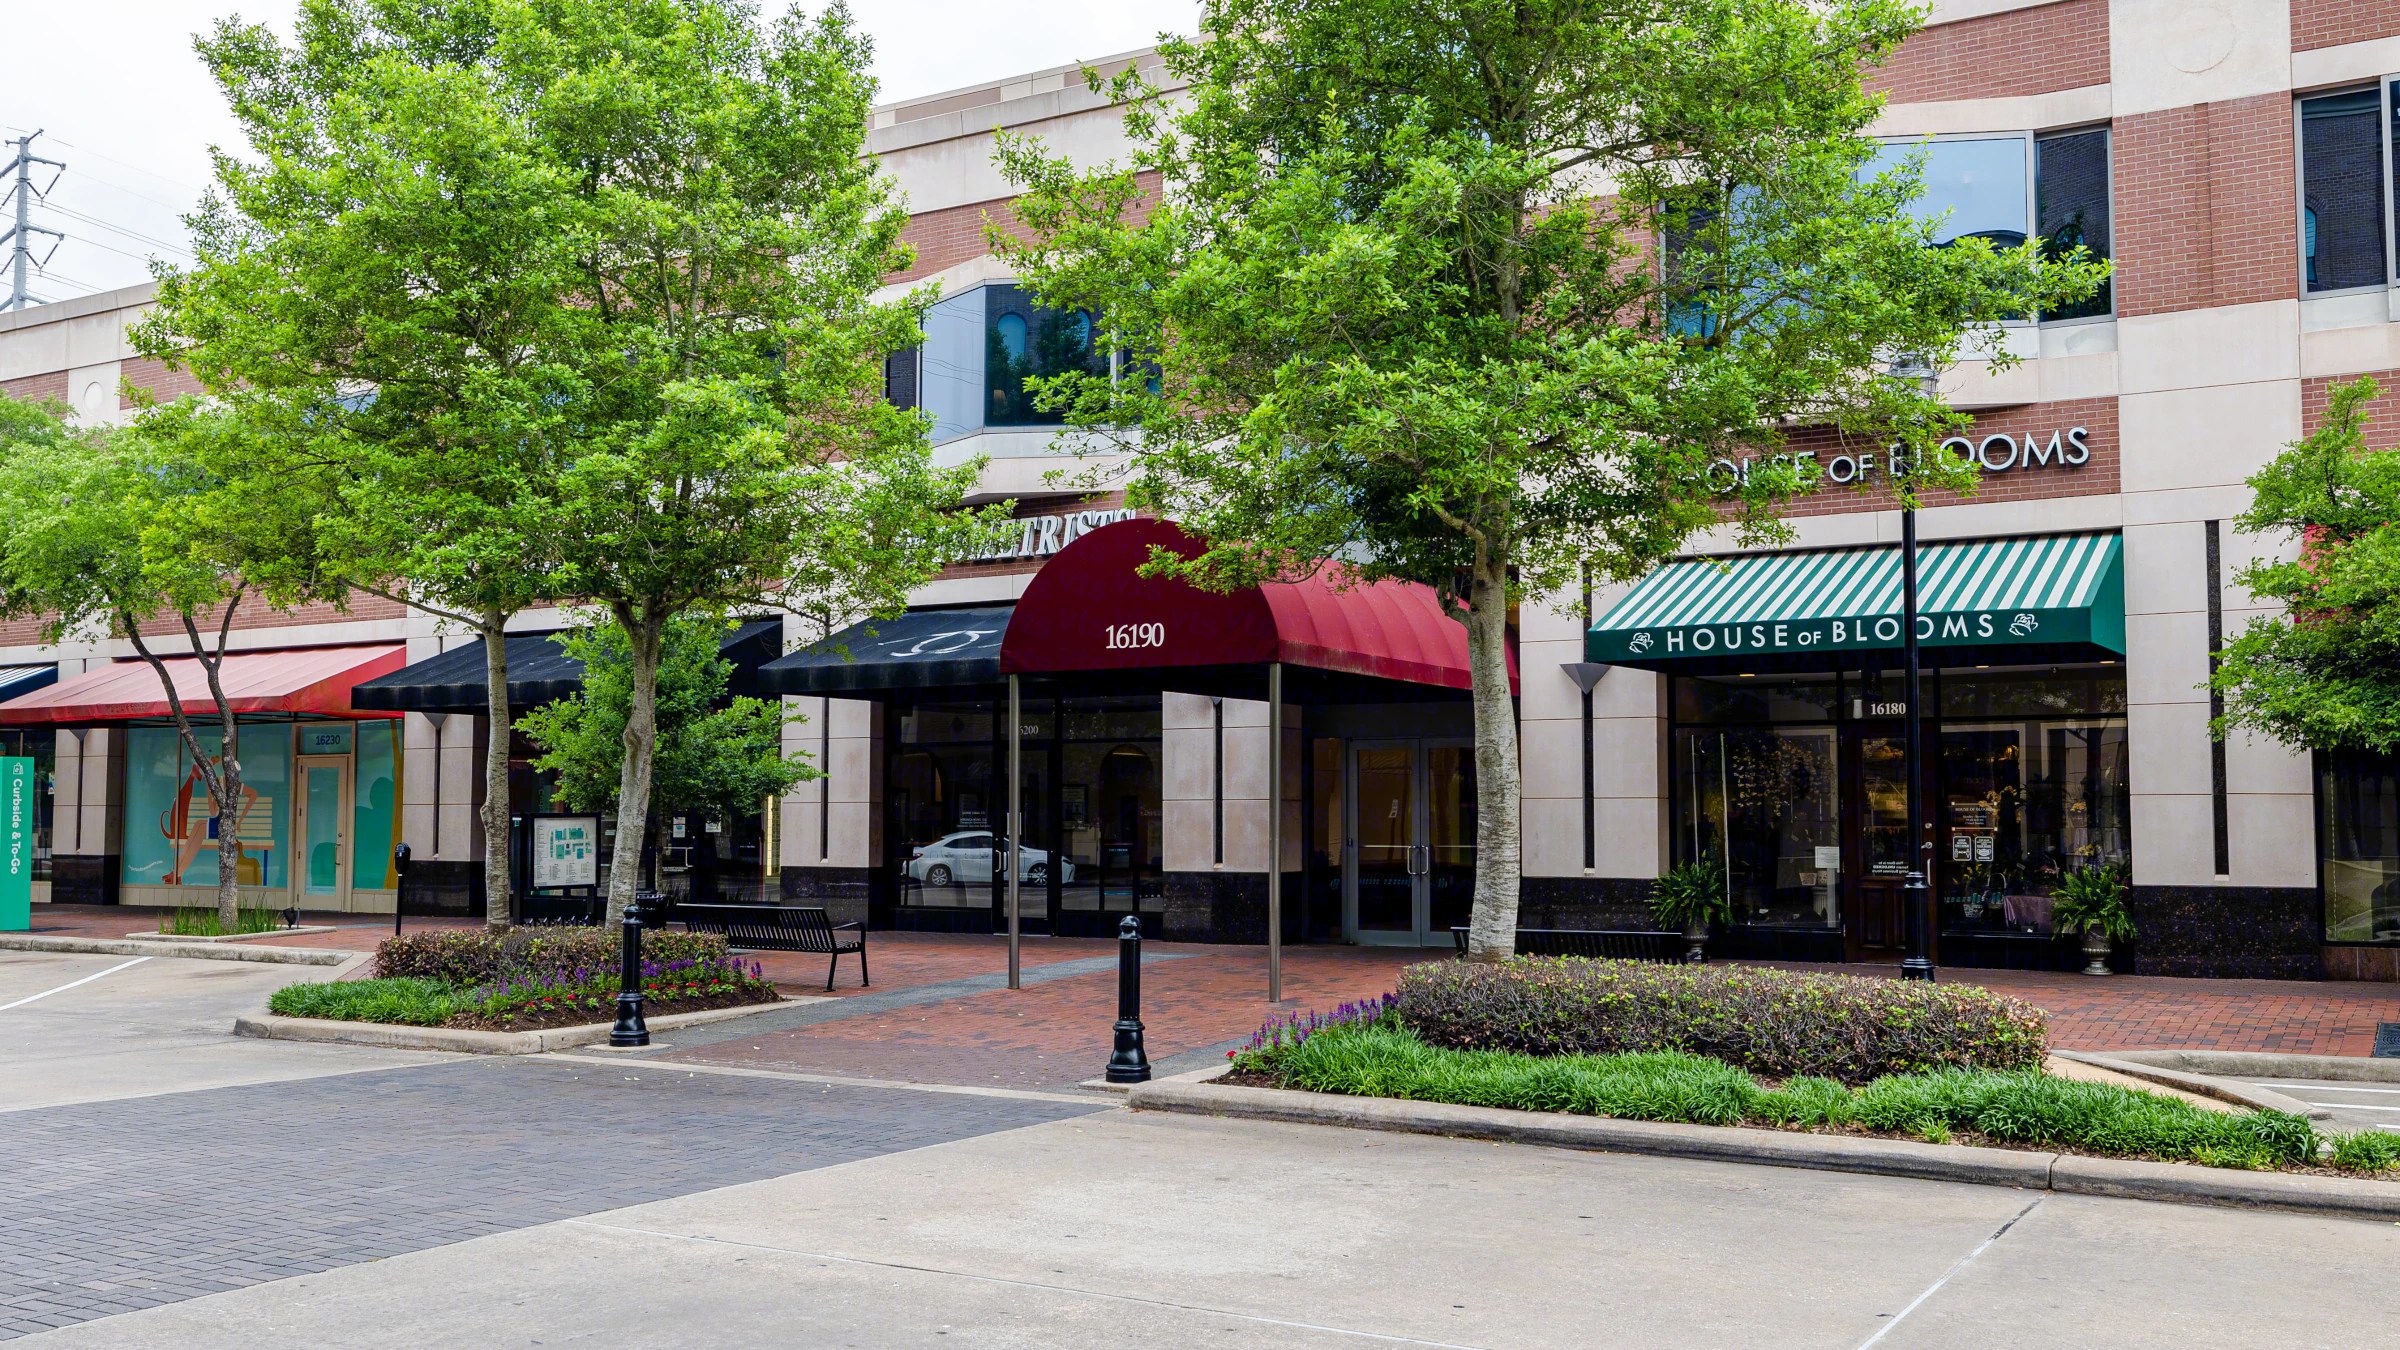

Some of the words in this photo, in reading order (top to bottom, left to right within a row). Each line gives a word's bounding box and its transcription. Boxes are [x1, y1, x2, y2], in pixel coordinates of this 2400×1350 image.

[1828, 453, 1874, 483] OF
[1105, 622, 1165, 649] 16190
[1666, 624, 1788, 653] HOUSE
[1797, 630, 1822, 646] OF
[1832, 613, 1994, 643] BLOOMS
[1870, 702, 1907, 715] 16180
[315, 734, 341, 746] 16230
[12, 778, 23, 829] Curbside
[11, 831, 22, 840] &
[10, 841, 21, 875] To-Go
